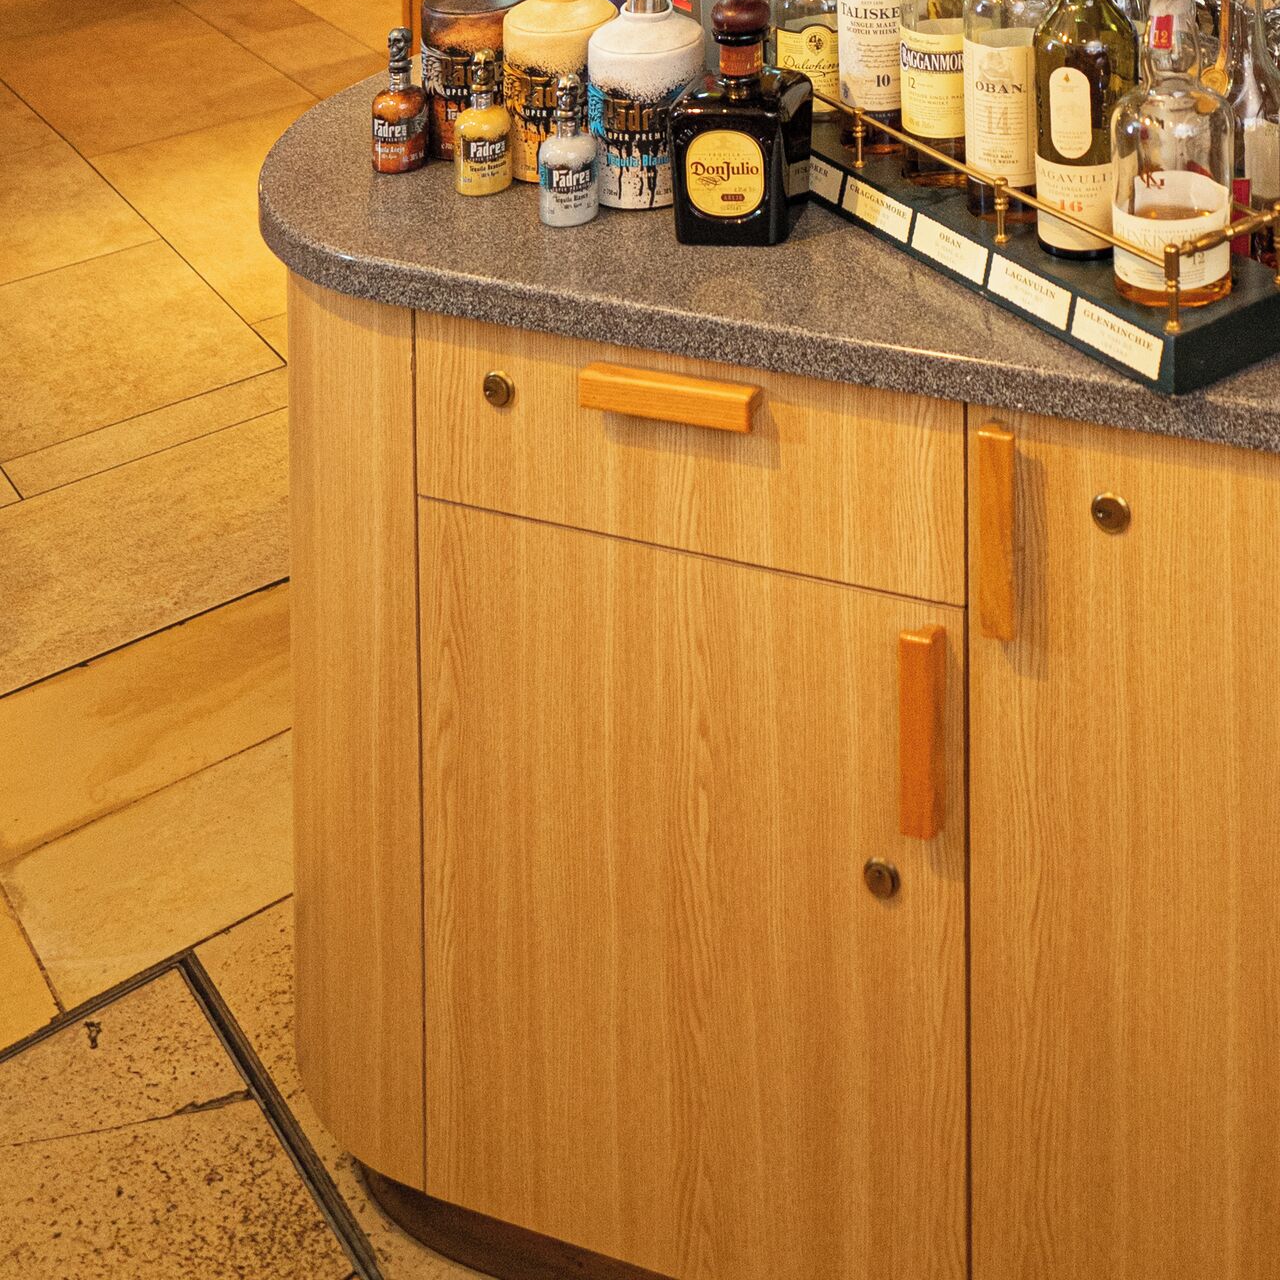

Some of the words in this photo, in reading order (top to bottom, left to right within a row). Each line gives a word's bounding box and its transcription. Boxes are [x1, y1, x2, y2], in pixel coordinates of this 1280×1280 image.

[875, 74, 892, 88] 10
[907, 77, 917, 90] 12
[975, 80, 1024, 94] OBAN
[986, 105, 1011, 136] 14
[849, 182, 908, 222] CRAGGANMORE
[1058, 199, 1084, 213] 16
[938, 231, 963, 250] OBAN
[1004, 266, 1057, 300] LAGAVULIN
[1082, 307, 1154, 352] GLENKINCHIE
